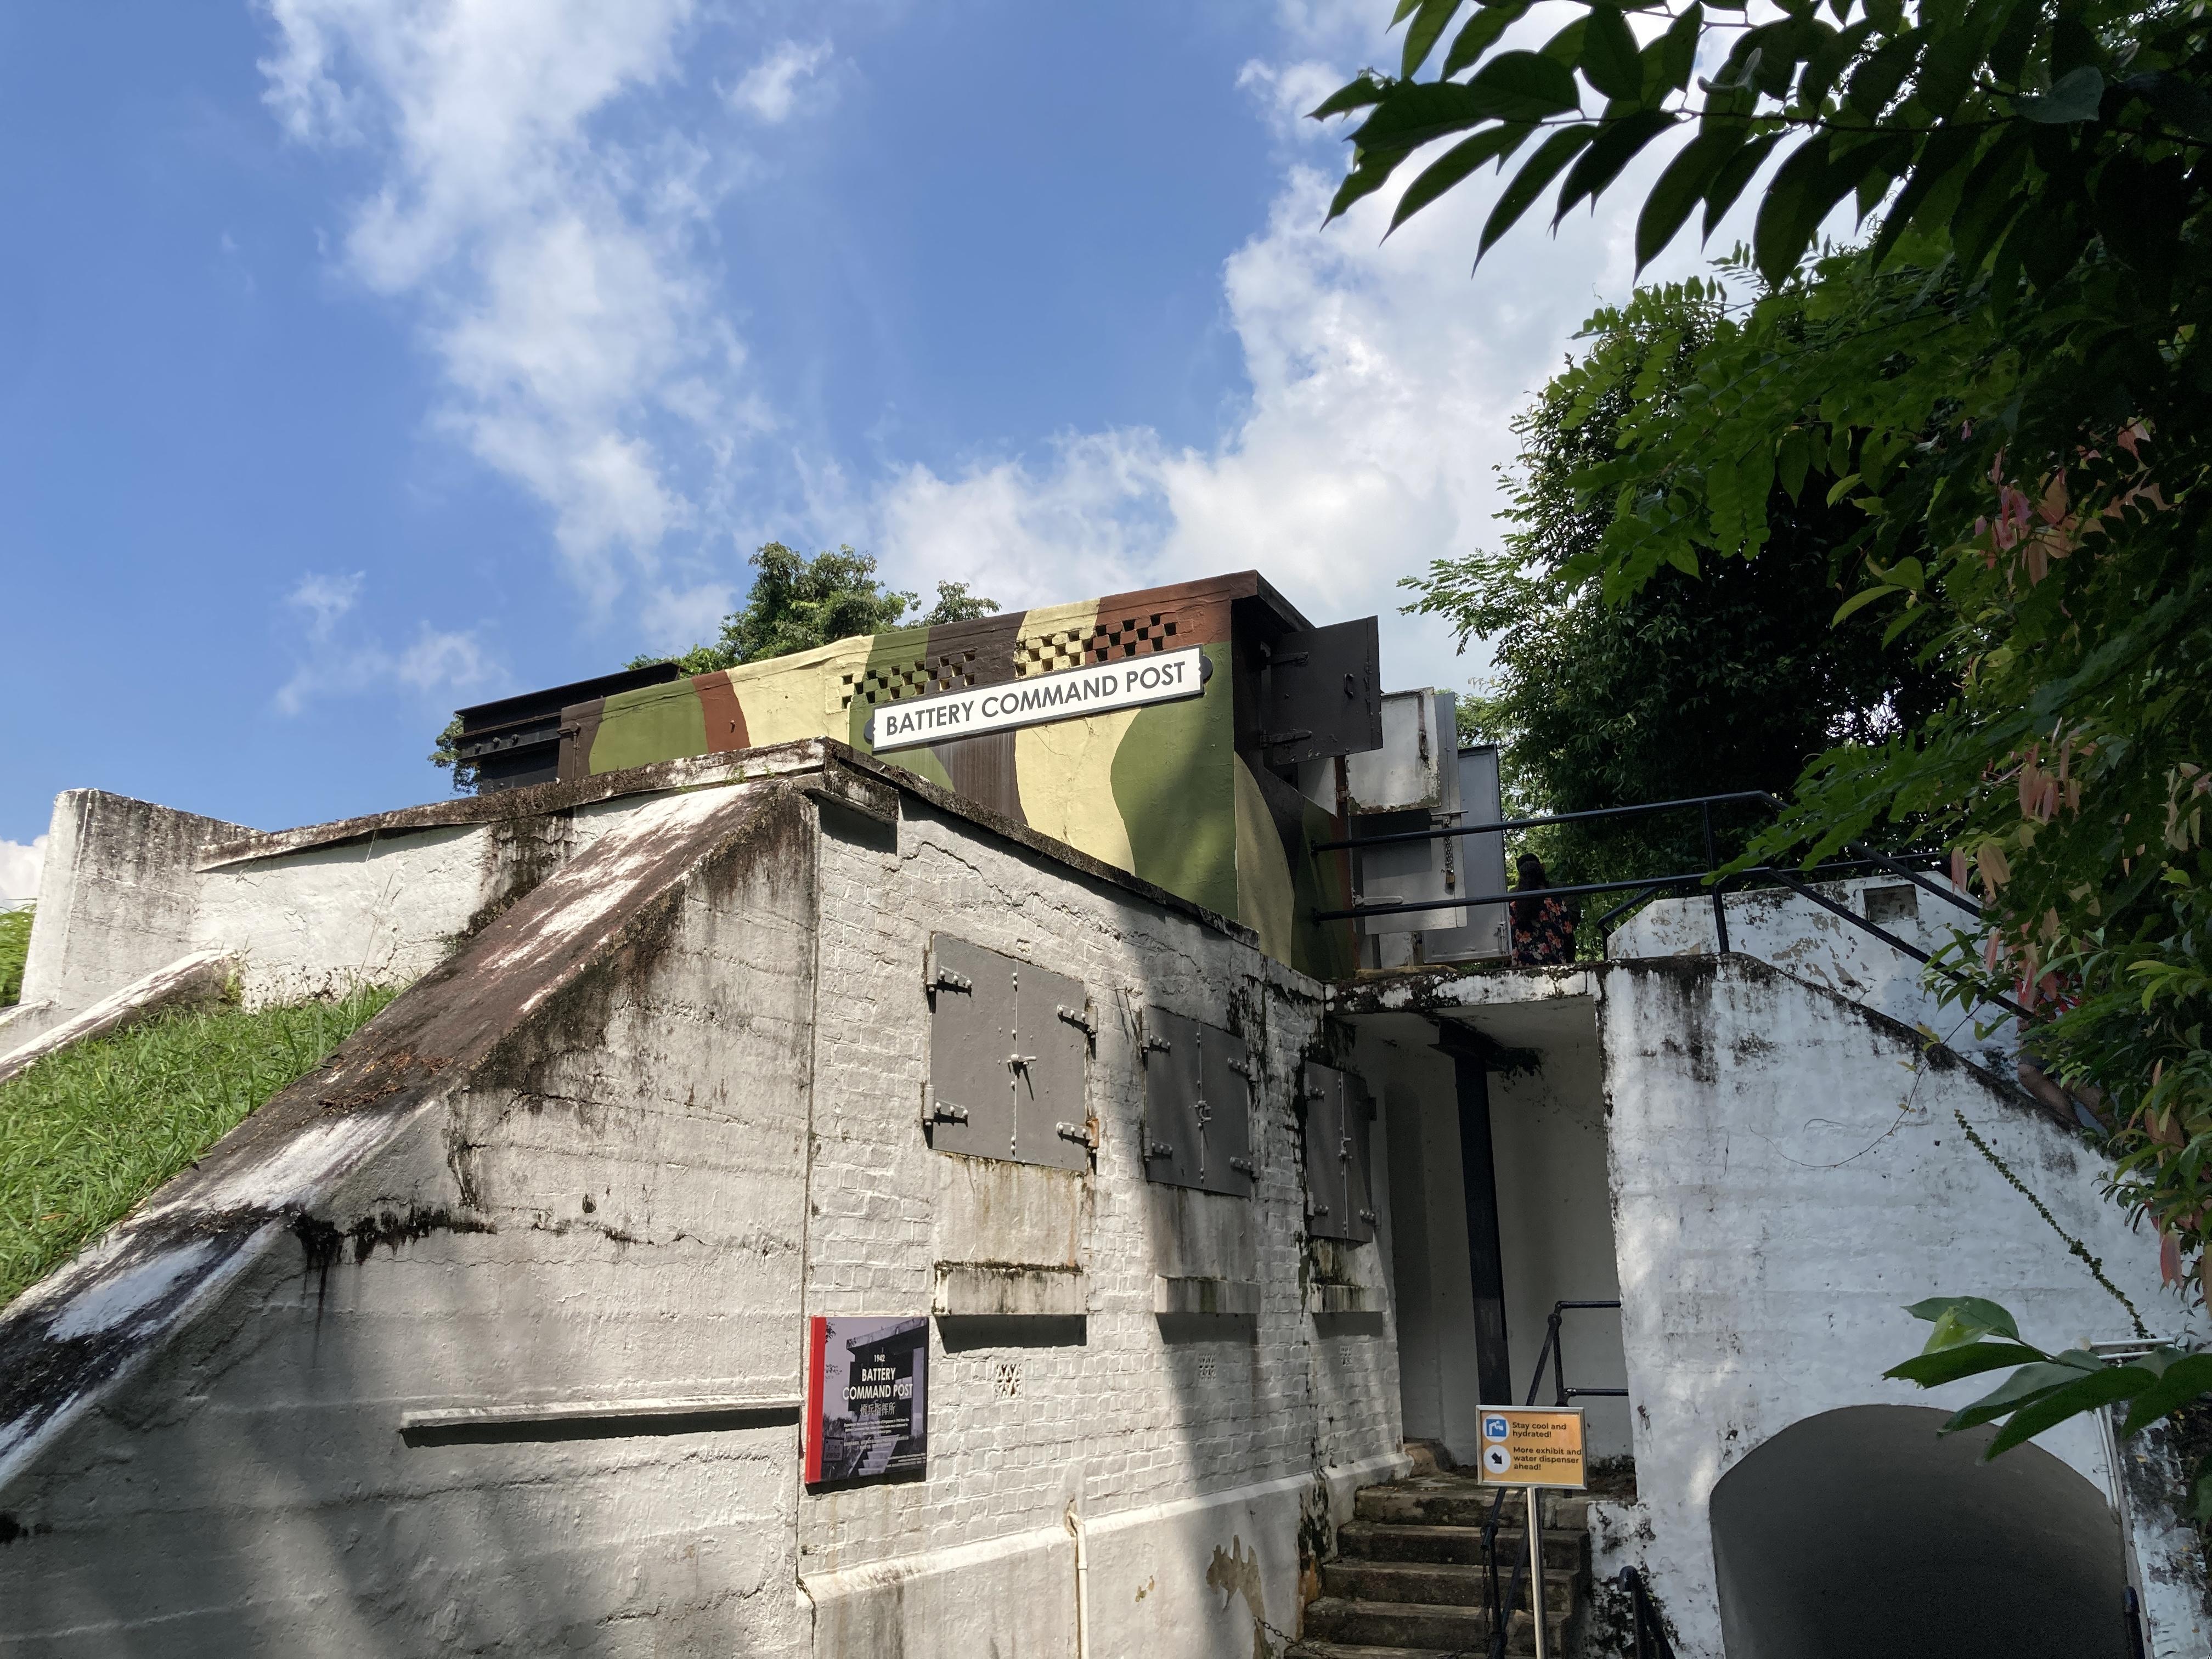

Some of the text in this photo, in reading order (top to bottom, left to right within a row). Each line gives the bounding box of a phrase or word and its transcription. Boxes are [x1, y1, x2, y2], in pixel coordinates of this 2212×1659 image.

[886, 661, 1185, 736] BATTERY COMMAND POST
[862, 1368, 896, 1381] BATTERY
[842, 1384, 913, 1400] COMMAND POST
[1513, 1421, 1530, 1430] Stay
[1539, 1455, 1579, 1464] dispenser
